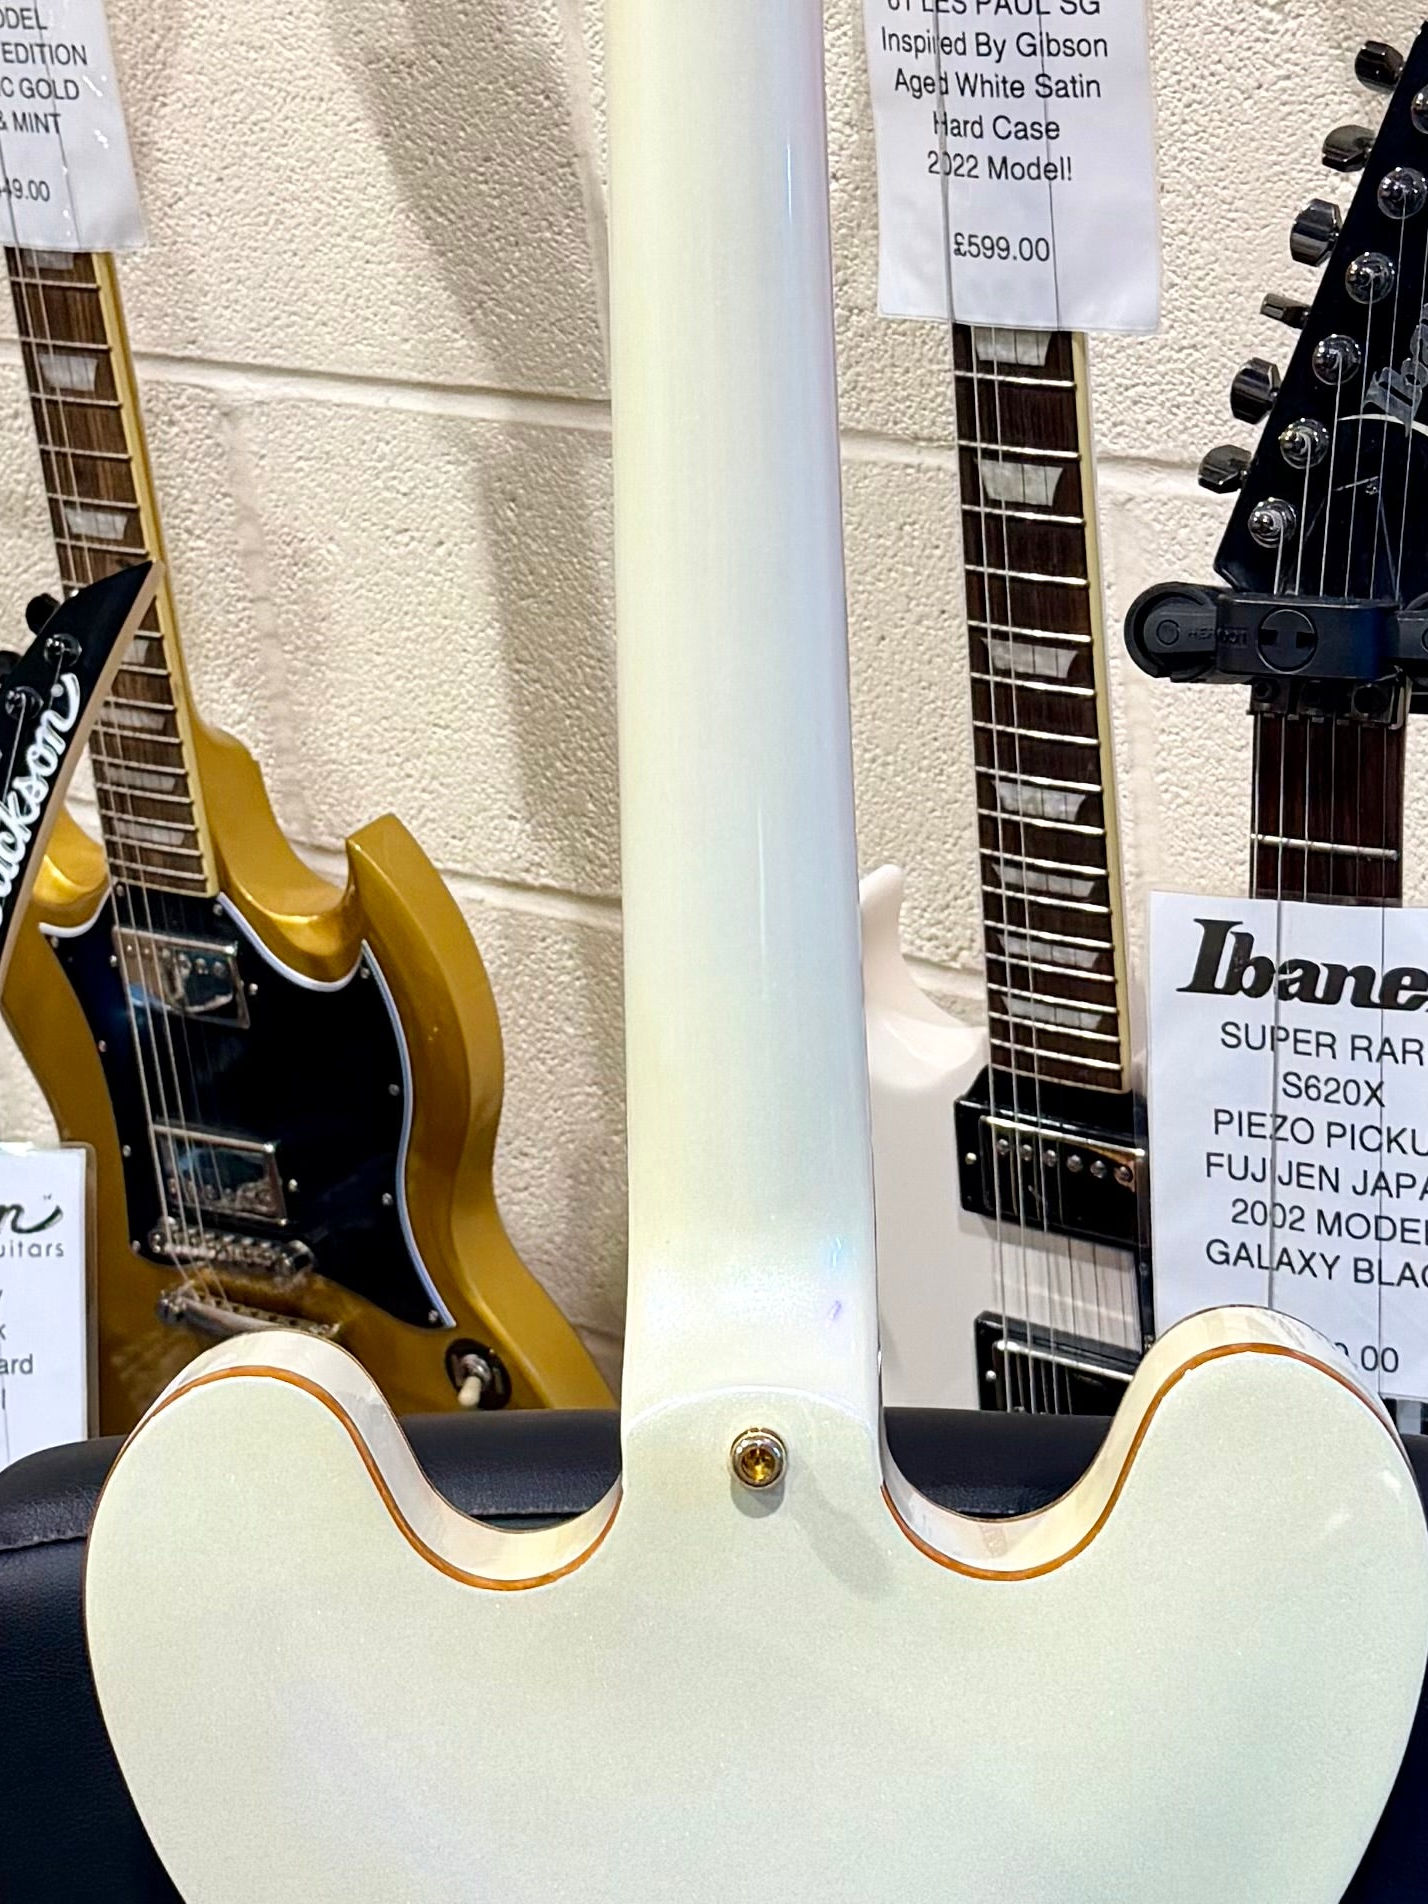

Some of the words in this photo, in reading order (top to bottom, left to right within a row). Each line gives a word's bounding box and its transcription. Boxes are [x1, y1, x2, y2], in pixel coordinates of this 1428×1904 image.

[2, 42, 88, 66] EDITION
[881, 26, 967, 60] Inspired
[976, 32, 1006, 63] By
[1016, 32, 1108, 59] Gibson
[18, 78, 80, 101] GOLD
[894, 68, 948, 101] Aged
[955, 72, 1025, 99] White
[1034, 74, 1102, 99] Satin
[12, 112, 61, 135] MINT
[933, 112, 983, 139] Hard
[993, 115, 1061, 141] Case
[927, 151, 980, 179] 2022
[988, 155, 1073, 182] Model!
[952, 233, 1051, 263] £599.00
[1220, 1021, 1338, 1061] SUPER
[1282, 1071, 1386, 1108] S620X
[1213, 1109, 1315, 1146] PIEZO
[1206, 1152, 1340, 1194] FUJJEN
[1231, 1198, 1306, 1232] 2002
[1205, 1239, 1342, 1280] GALAXY
